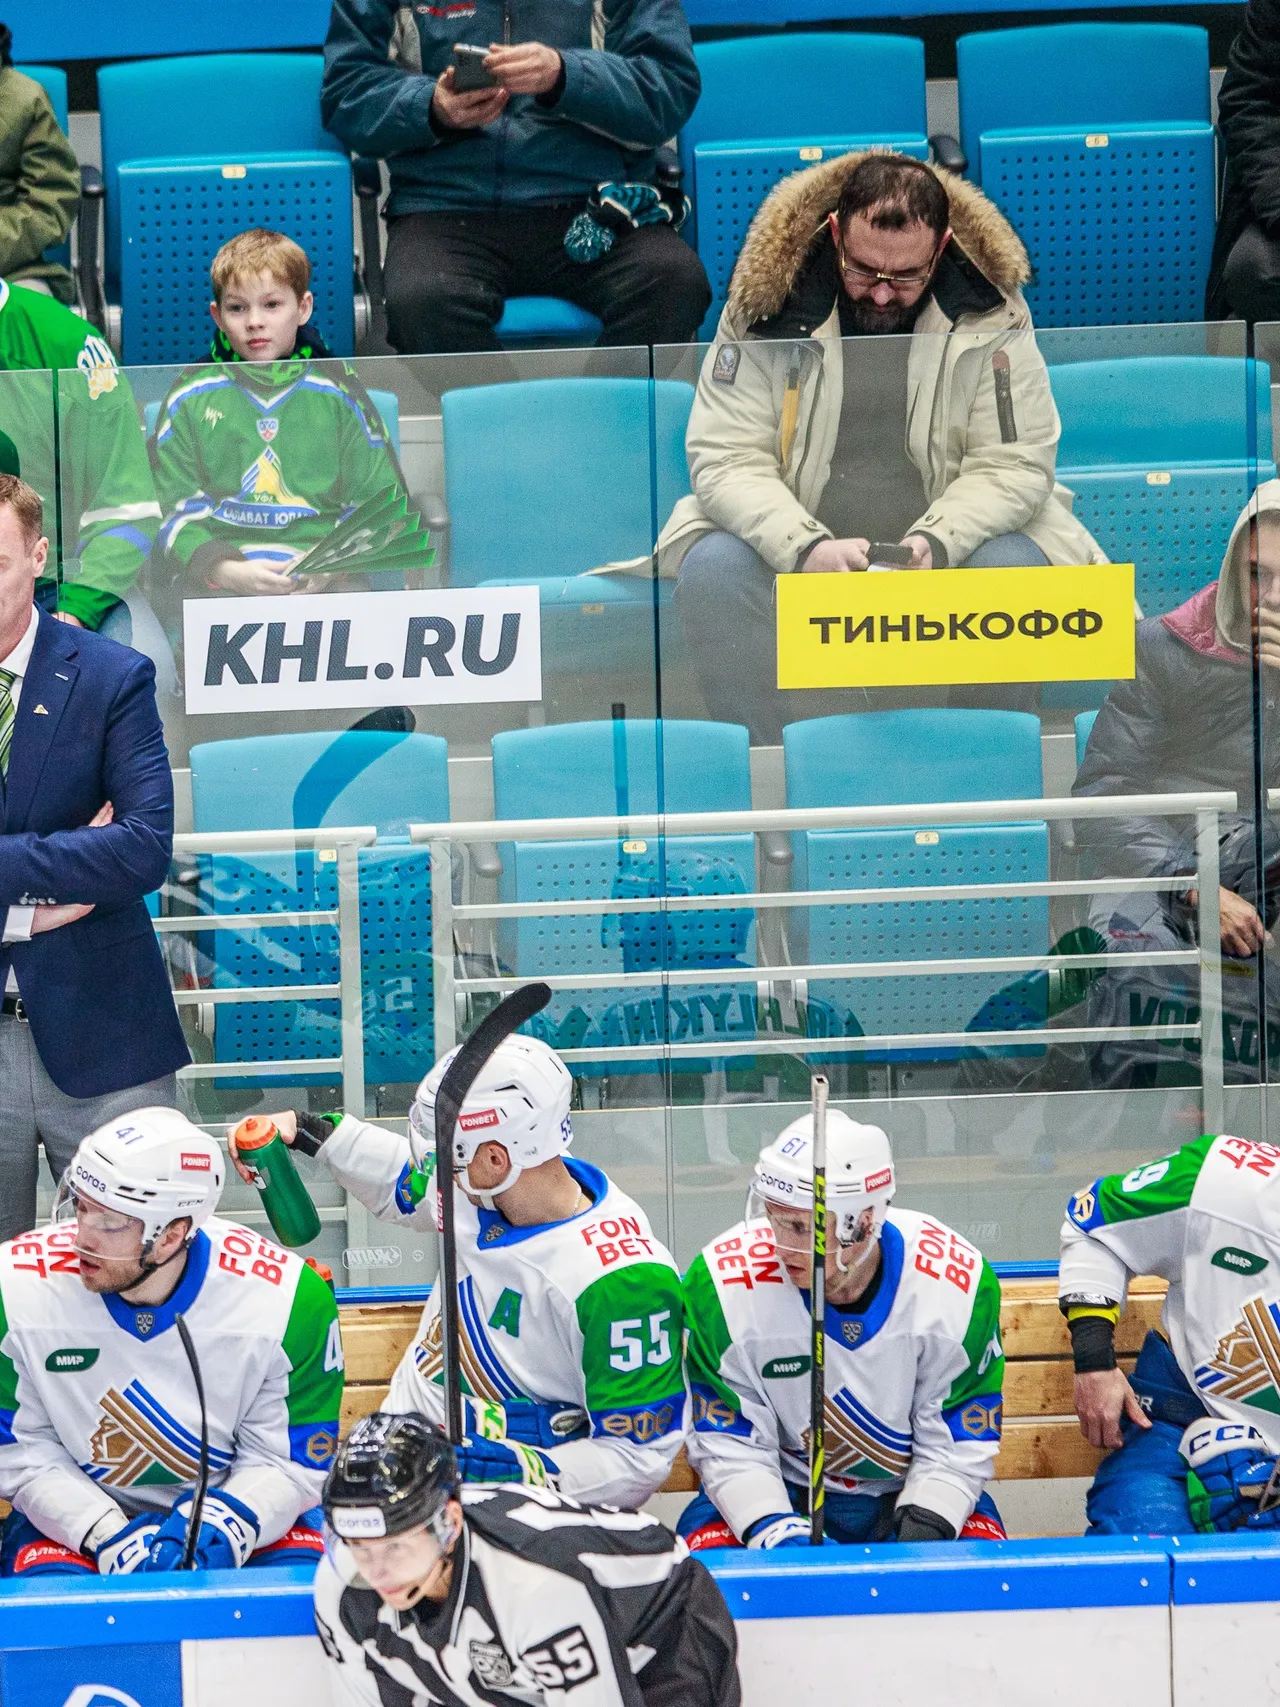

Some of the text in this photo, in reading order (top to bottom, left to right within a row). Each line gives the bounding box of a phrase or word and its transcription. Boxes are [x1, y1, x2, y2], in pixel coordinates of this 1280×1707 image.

[810, 608, 1103, 644] ТИНЬКОФФ
[204, 613, 521, 686] KHL.RU
[116, 1126, 144, 1145] 41
[462, 1115, 496, 1128] FONBET
[781, 1137, 808, 1157] 61
[1219, 1138, 1253, 1169] ET
[1247, 1144, 1280, 1177] ON
[182, 1157, 211, 1168] FONBET
[76, 1165, 106, 1193] согаз
[761, 1173, 793, 1194] согаз
[178, 1199, 204, 1208] CCM
[581, 1216, 641, 1246] FON
[12, 1234, 47, 1278] ET
[252, 1238, 288, 1286] BE
[596, 1237, 653, 1267] BET
[714, 1237, 754, 1290] BET
[748, 1227, 784, 1284] FON
[915, 1220, 946, 1280] FON
[945, 1234, 975, 1295] BET
[610, 1310, 672, 1373] 55
[56, 1355, 84, 1366] МИР
[773, 1362, 802, 1373] МИР
[291, 1531, 325, 1545] Бан
[690, 1528, 732, 1551] Альф
[23, 1547, 69, 1565] Альф
[522, 1631, 594, 1688] 55
